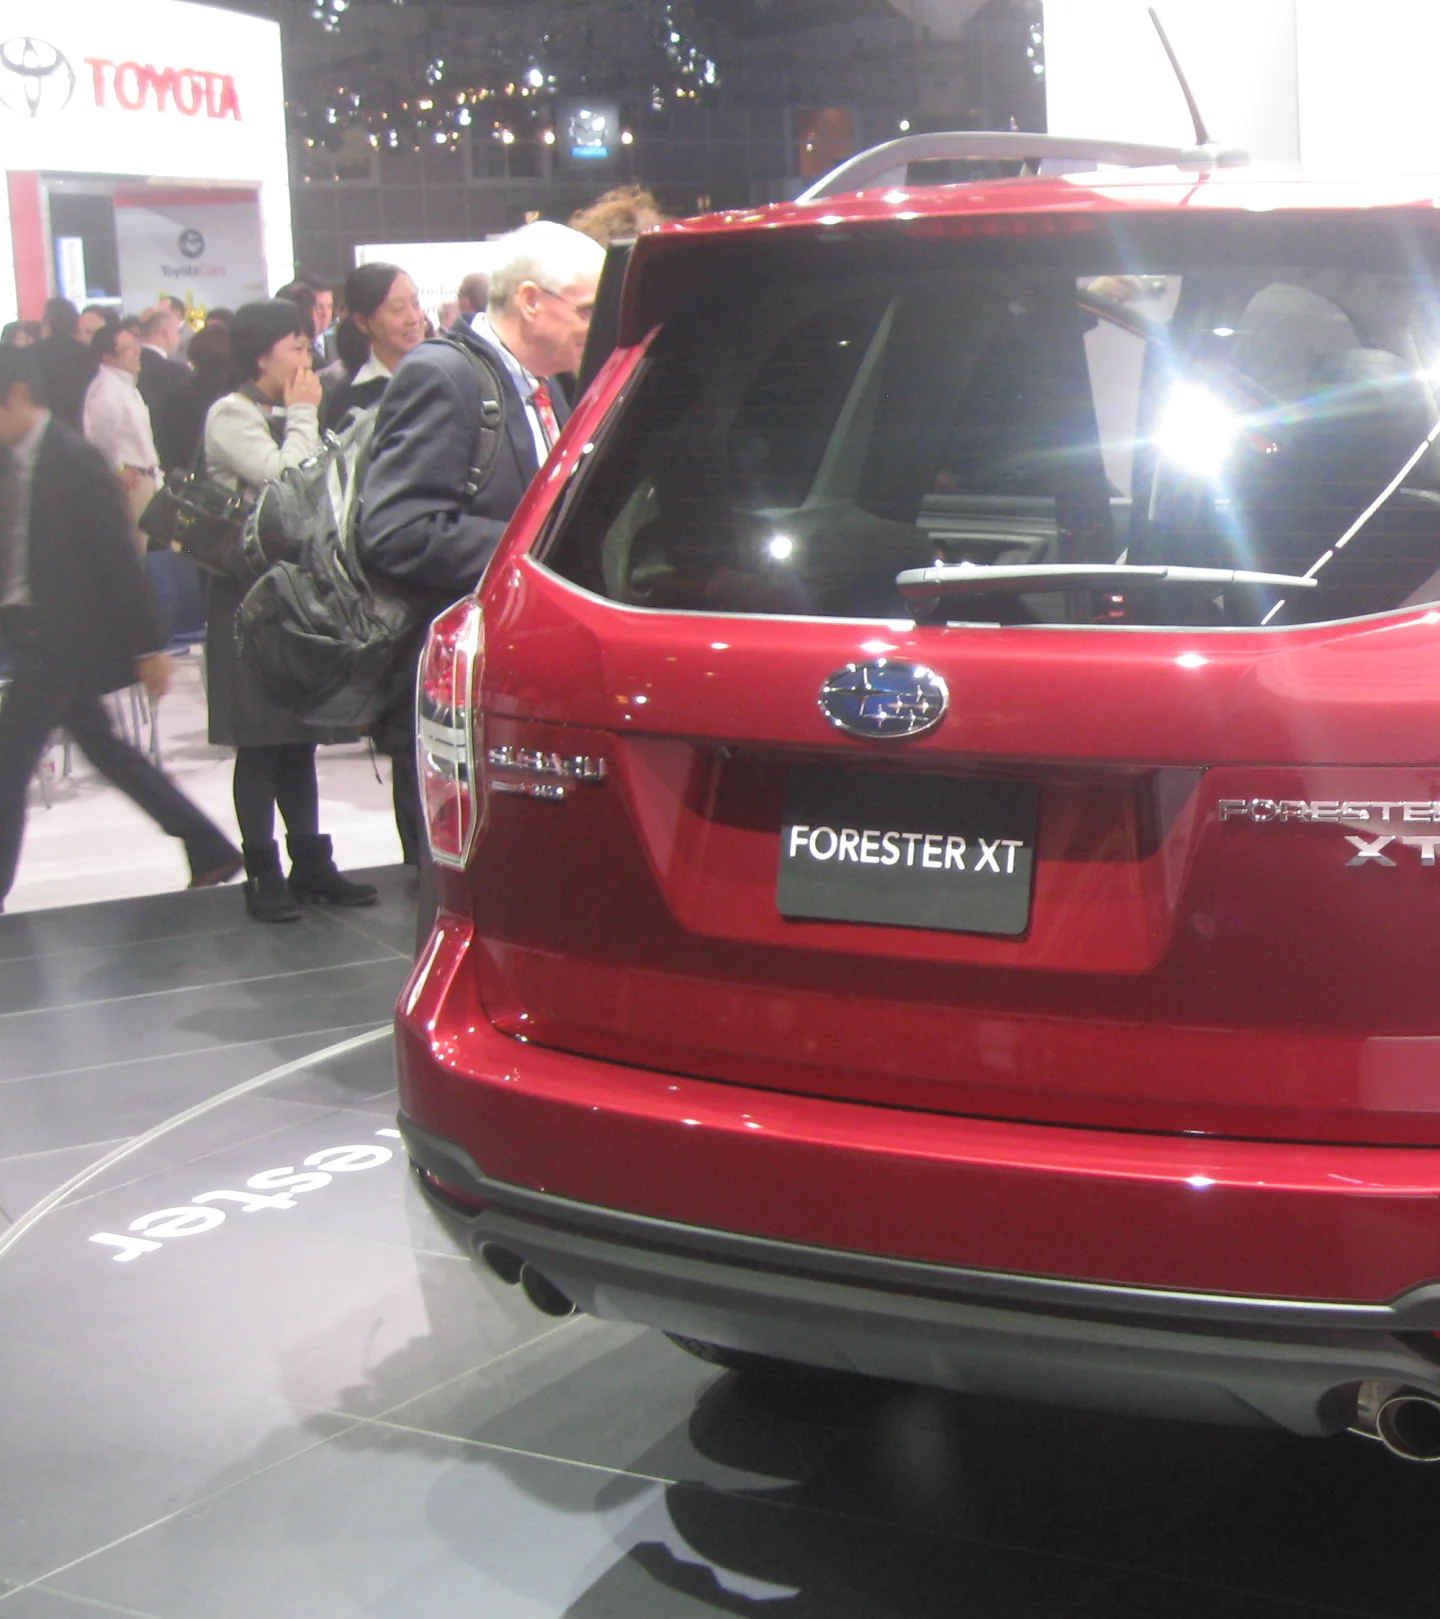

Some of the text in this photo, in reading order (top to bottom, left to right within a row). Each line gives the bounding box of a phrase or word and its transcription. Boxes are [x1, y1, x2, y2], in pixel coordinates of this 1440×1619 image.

[84, 57, 243, 122] TOYOTA
[790, 825, 1024, 874] FORESTER XT
